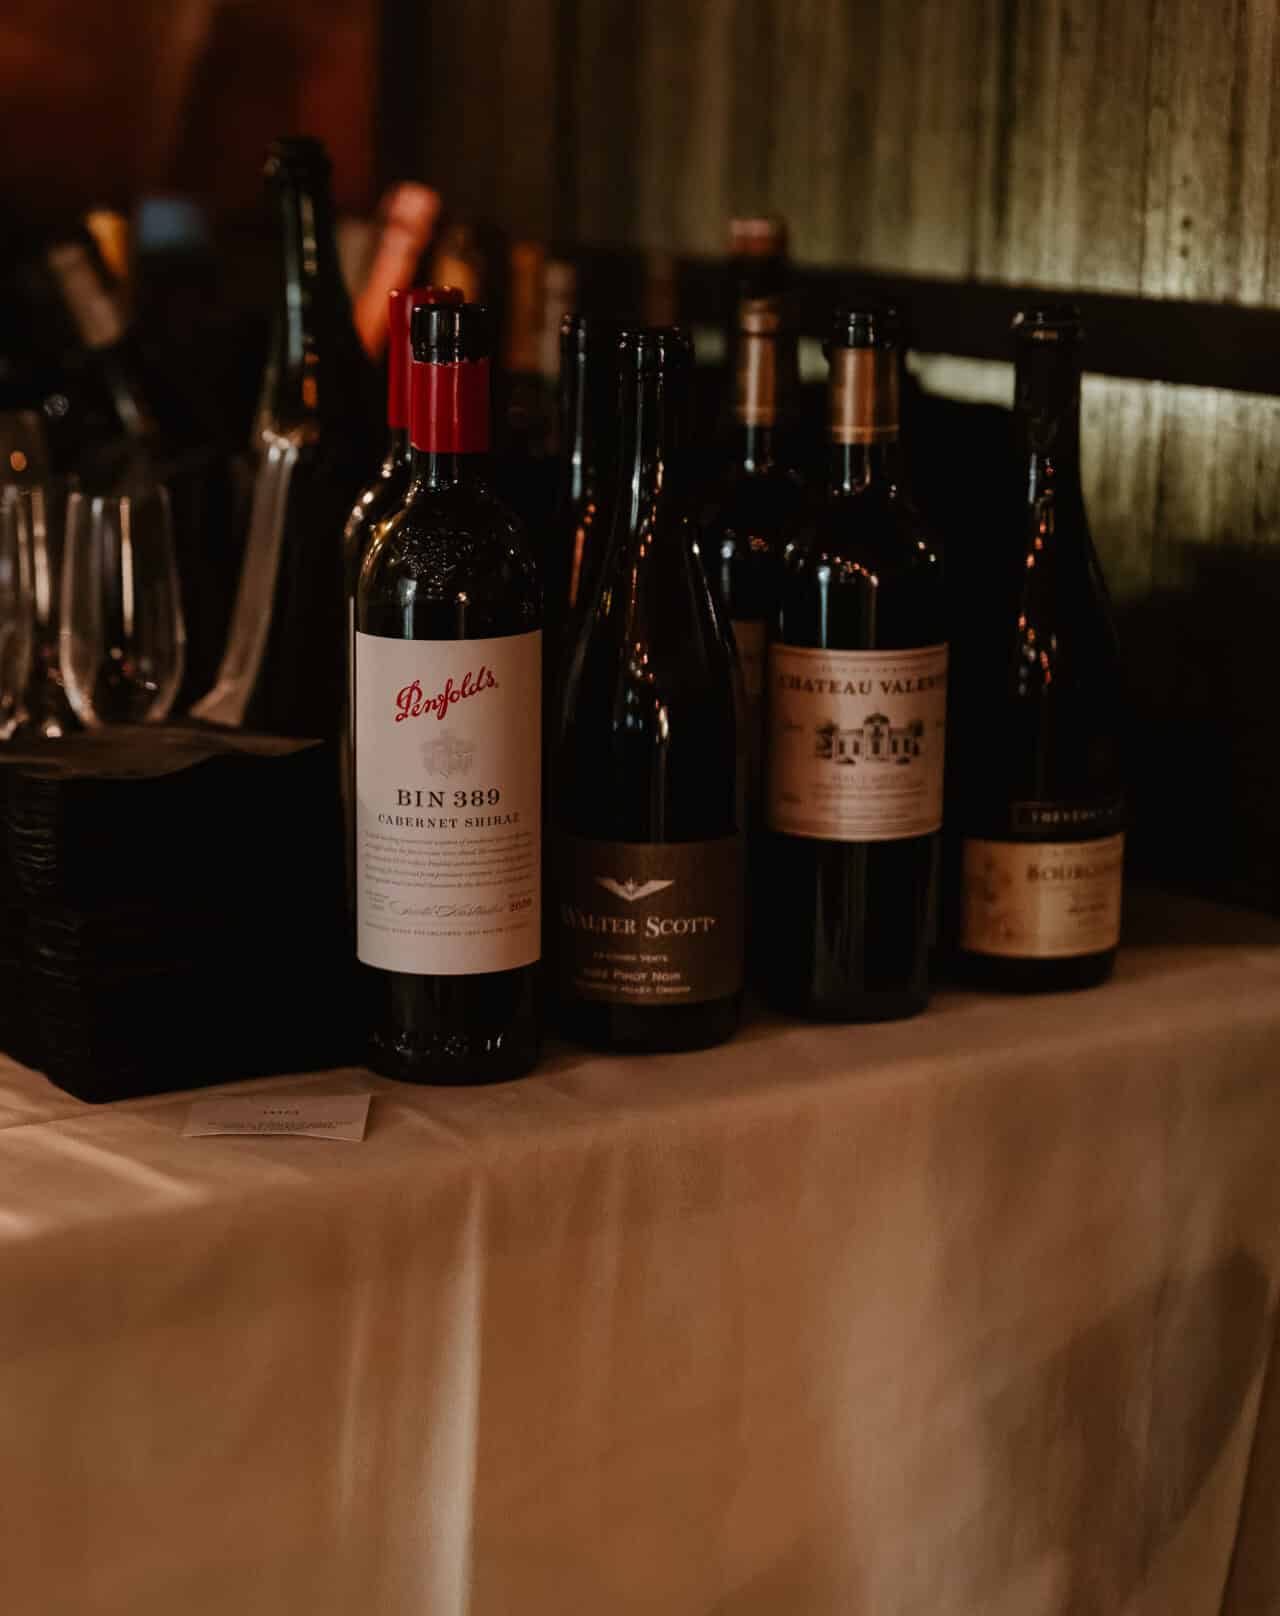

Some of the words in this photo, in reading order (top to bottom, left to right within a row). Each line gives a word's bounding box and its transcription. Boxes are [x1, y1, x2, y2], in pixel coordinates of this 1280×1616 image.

[397, 789, 446, 808] BIN
[453, 788, 501, 808] 389
[378, 813, 459, 829] CABERNET
[464, 811, 520, 828] SHIRAZ
[559, 903, 637, 936] WALTER
[644, 914, 718, 939] SCOTT
